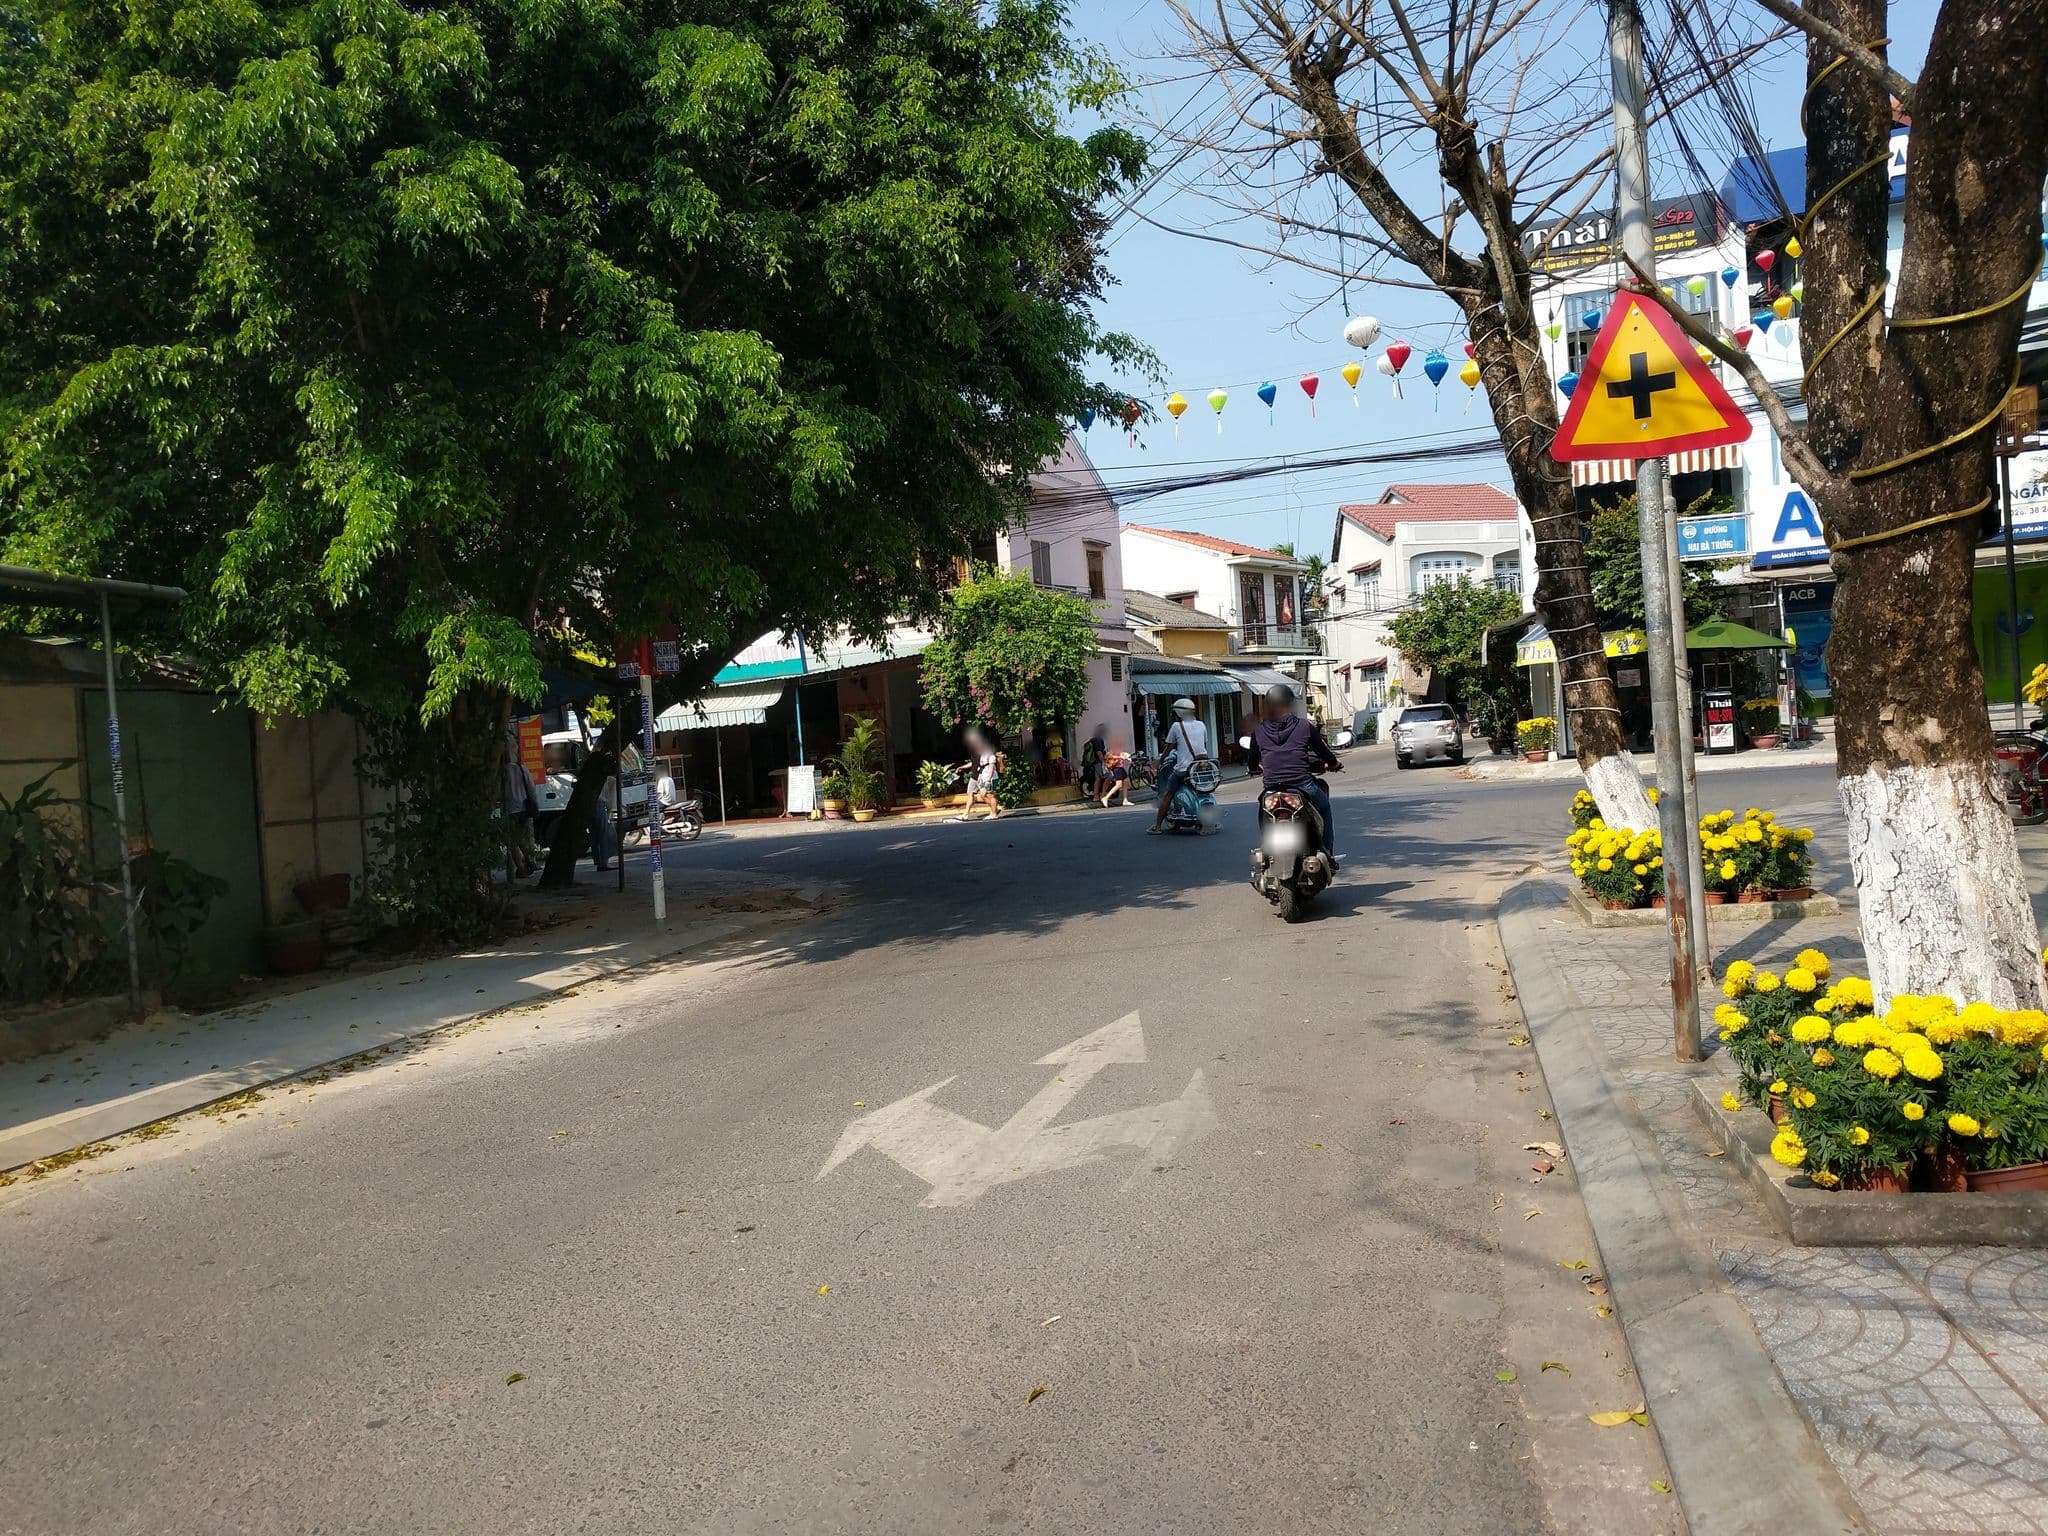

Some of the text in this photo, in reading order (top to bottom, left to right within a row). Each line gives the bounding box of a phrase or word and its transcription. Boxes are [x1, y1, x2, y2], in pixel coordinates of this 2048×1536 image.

[1666, 208, 1694, 224] Spa
[1524, 218, 1608, 250] Thái
[1687, 544, 1700, 552] HAI
[1700, 541, 1711, 551] BÀ
[1788, 588, 1817, 600] ACB
[1519, 645, 1553, 661] Thá
